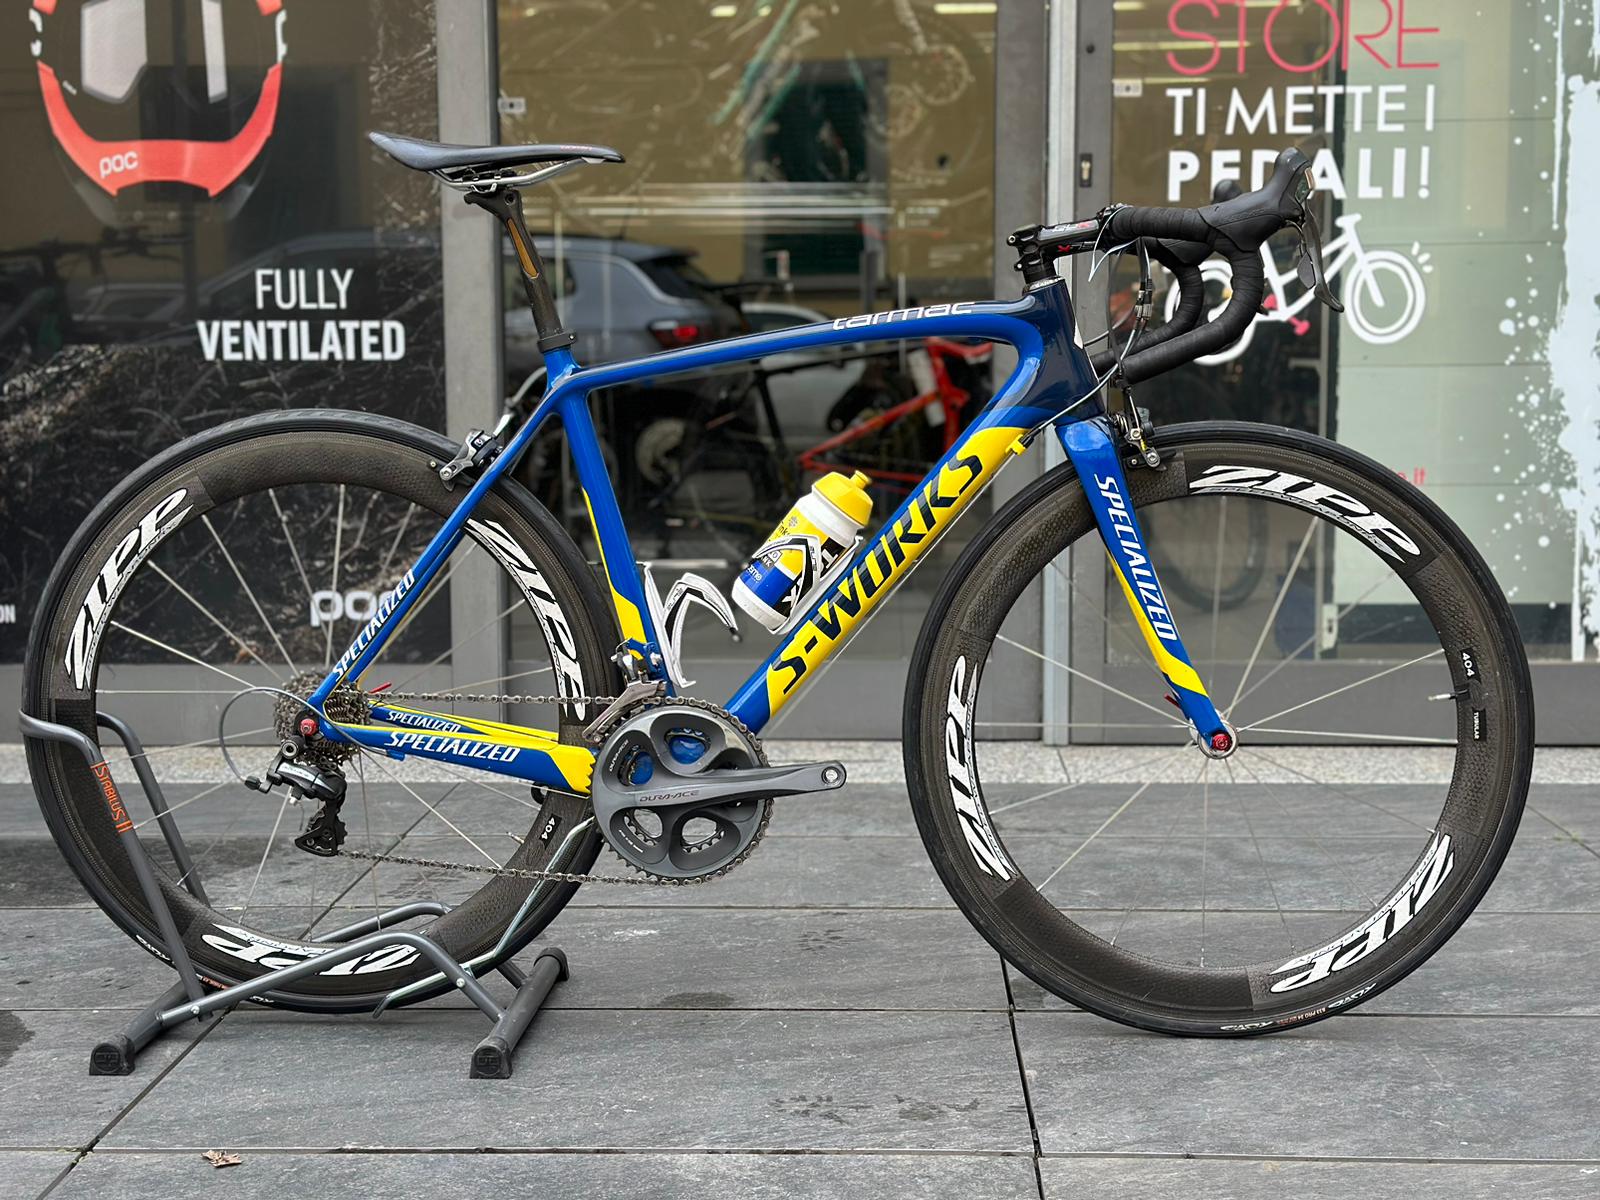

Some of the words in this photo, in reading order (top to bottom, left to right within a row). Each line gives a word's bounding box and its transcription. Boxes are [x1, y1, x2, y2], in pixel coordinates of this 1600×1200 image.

[1166, 0, 1440, 75] STORE
[1166, 87, 1206, 136] TI
[1225, 85, 1407, 134] METTE
[1425, 84, 1435, 132] I
[255, 268, 354, 310] FULLY
[832, 301, 976, 331] tarmac
[196, 320, 406, 361] VENTILATED
[1189, 465, 1421, 556] ZIPP
[65, 487, 188, 690] ZIPP
[772, 455, 983, 695] S-WORKS
[1093, 473, 1178, 641] SPECIALIZED
[332, 568, 416, 682] SPECIALIZED
[467, 518, 586, 721] ZIPP
[1462, 652, 1475, 677] 404
[384, 731, 521, 763] SPECIALIZED
[386, 710, 462, 733] SPECIALIZED
[639, 789, 700, 803] DURA-ACE
[945, 655, 1011, 881] ZIPP
[541, 817, 555, 840] 404
[1269, 834, 1455, 993] ZIPP
